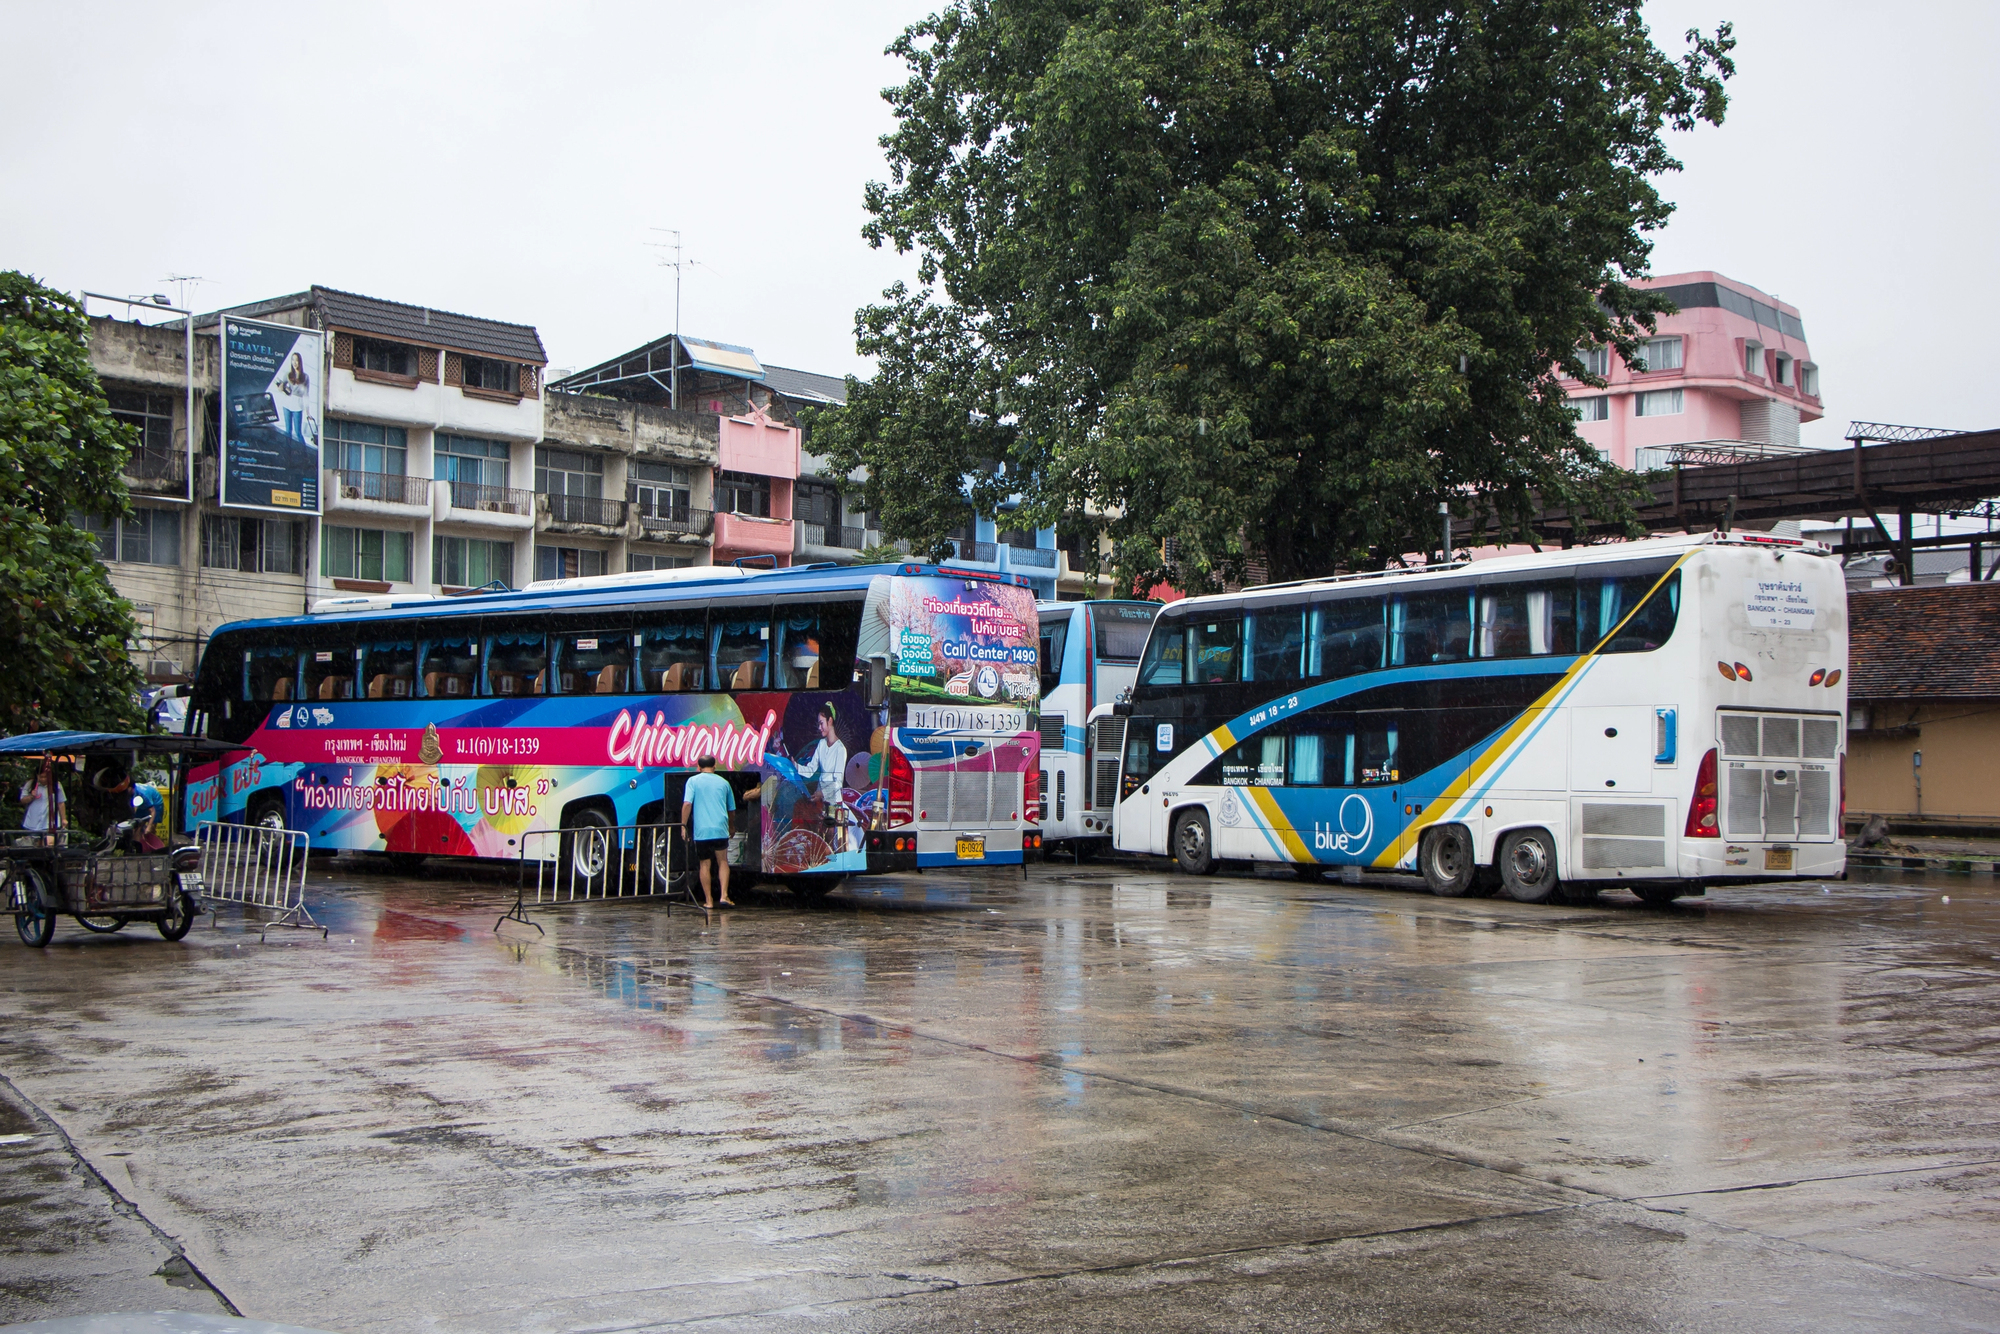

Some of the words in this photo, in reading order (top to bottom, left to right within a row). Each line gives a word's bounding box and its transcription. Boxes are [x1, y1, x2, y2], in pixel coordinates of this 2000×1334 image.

[230, 340, 274, 356] TRAVEL
[1747, 604, 1776, 613] BANGKOK
[1783, 606, 1815, 615] CHIANGMAI
[970, 618, 997, 635] ไปกับ
[901, 631, 931, 645] ส่งของ
[902, 644, 932, 660] จองตั๋ว
[943, 643, 966, 658] Call
[969, 645, 1009, 661] Center
[1012, 648, 1036, 662] 1490
[898, 661, 935, 675] ทัวร์เหมา
[949, 685, 970, 695] บขส
[1268, 705, 1278, 717] 18
[1287, 696, 1298, 709] 23
[915, 708, 1021, 731] ม.1(ก)/18-1339
[324, 738, 363, 756] กรุงเทพฯ
[371, 733, 407, 752] เชียงใหม่
[456, 736, 540, 756] ม.1(ก)/18-1339
[336, 756, 365, 764] BANGKOK
[369, 756, 402, 764] CHIANGMAI
[232, 758, 262, 795] BUS
[1223, 777, 1248, 786] BANGKOK
[1254, 777, 1284, 786] CHIANGMAI
[1315, 821, 1348, 851] blue
